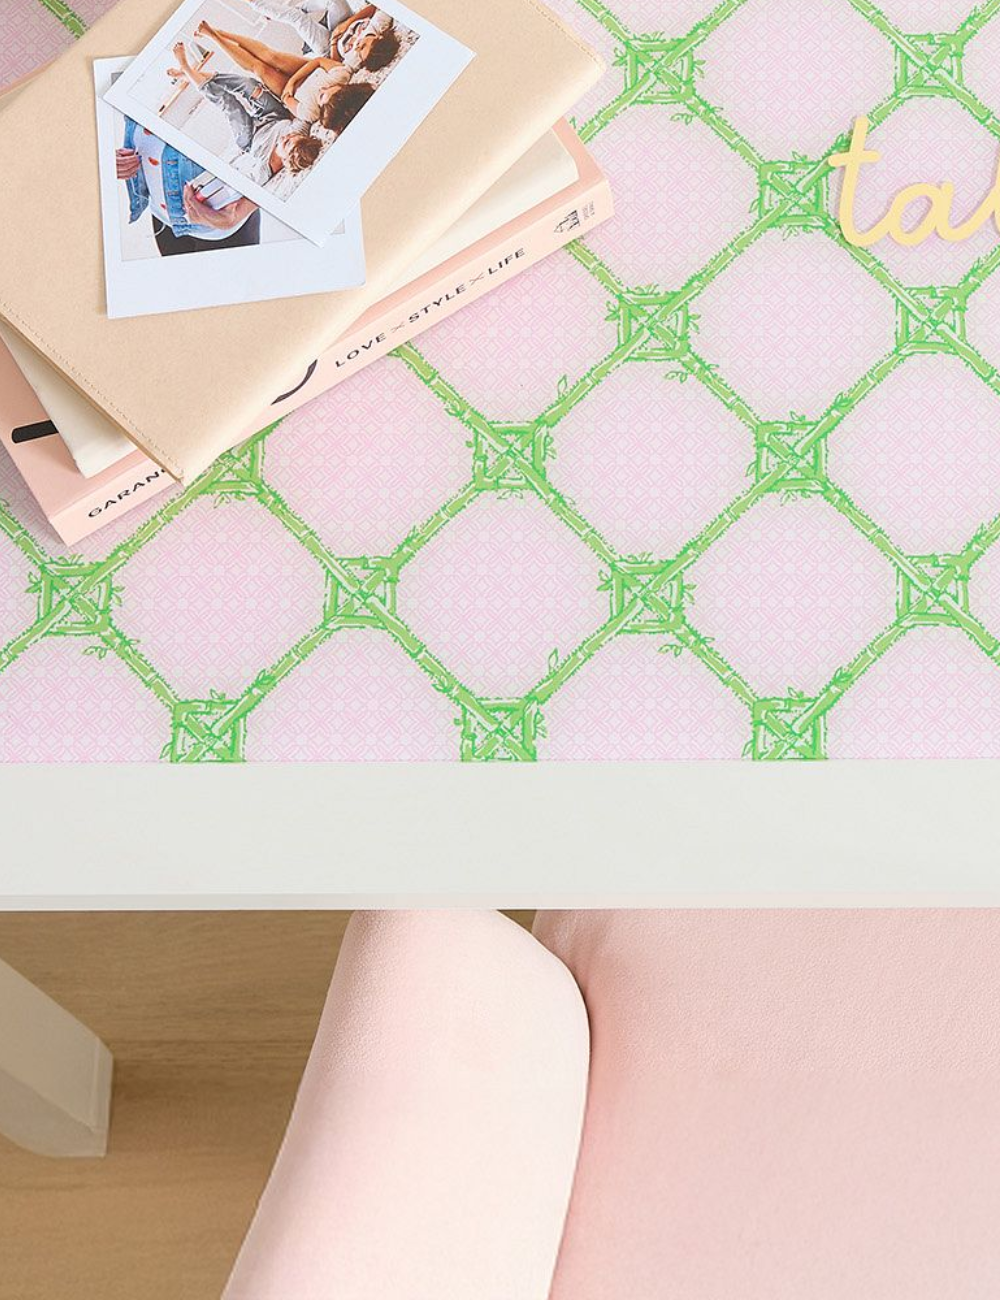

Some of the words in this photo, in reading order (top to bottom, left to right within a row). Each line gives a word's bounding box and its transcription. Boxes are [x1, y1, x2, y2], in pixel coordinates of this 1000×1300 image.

[335, 332, 387, 369] LOVE
[408, 283, 466, 324] STYLE
[487, 247, 526, 276] LIFE
[88, 468, 166, 518] GARAN
